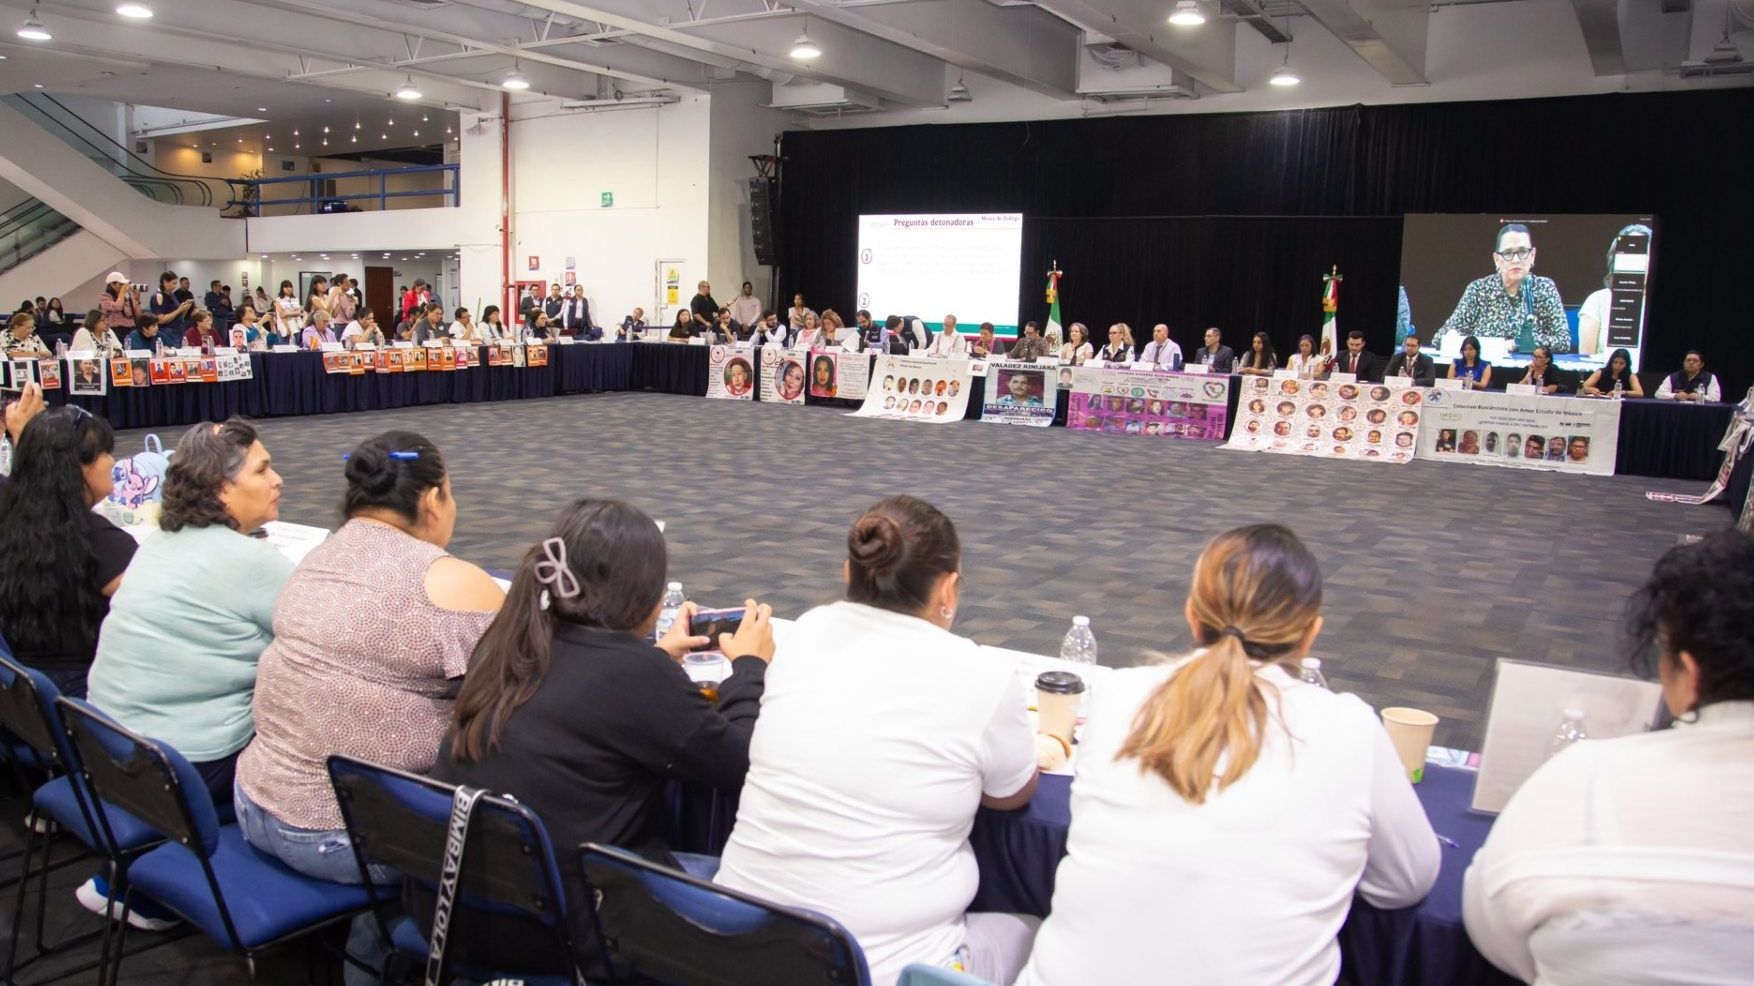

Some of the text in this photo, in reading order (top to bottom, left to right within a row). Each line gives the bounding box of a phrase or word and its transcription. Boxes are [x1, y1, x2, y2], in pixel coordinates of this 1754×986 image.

[893, 218, 928, 228] Preguntas
[930, 218, 974, 227] detonadoras
[986, 404, 1053, 413] DESAPARECIDO
